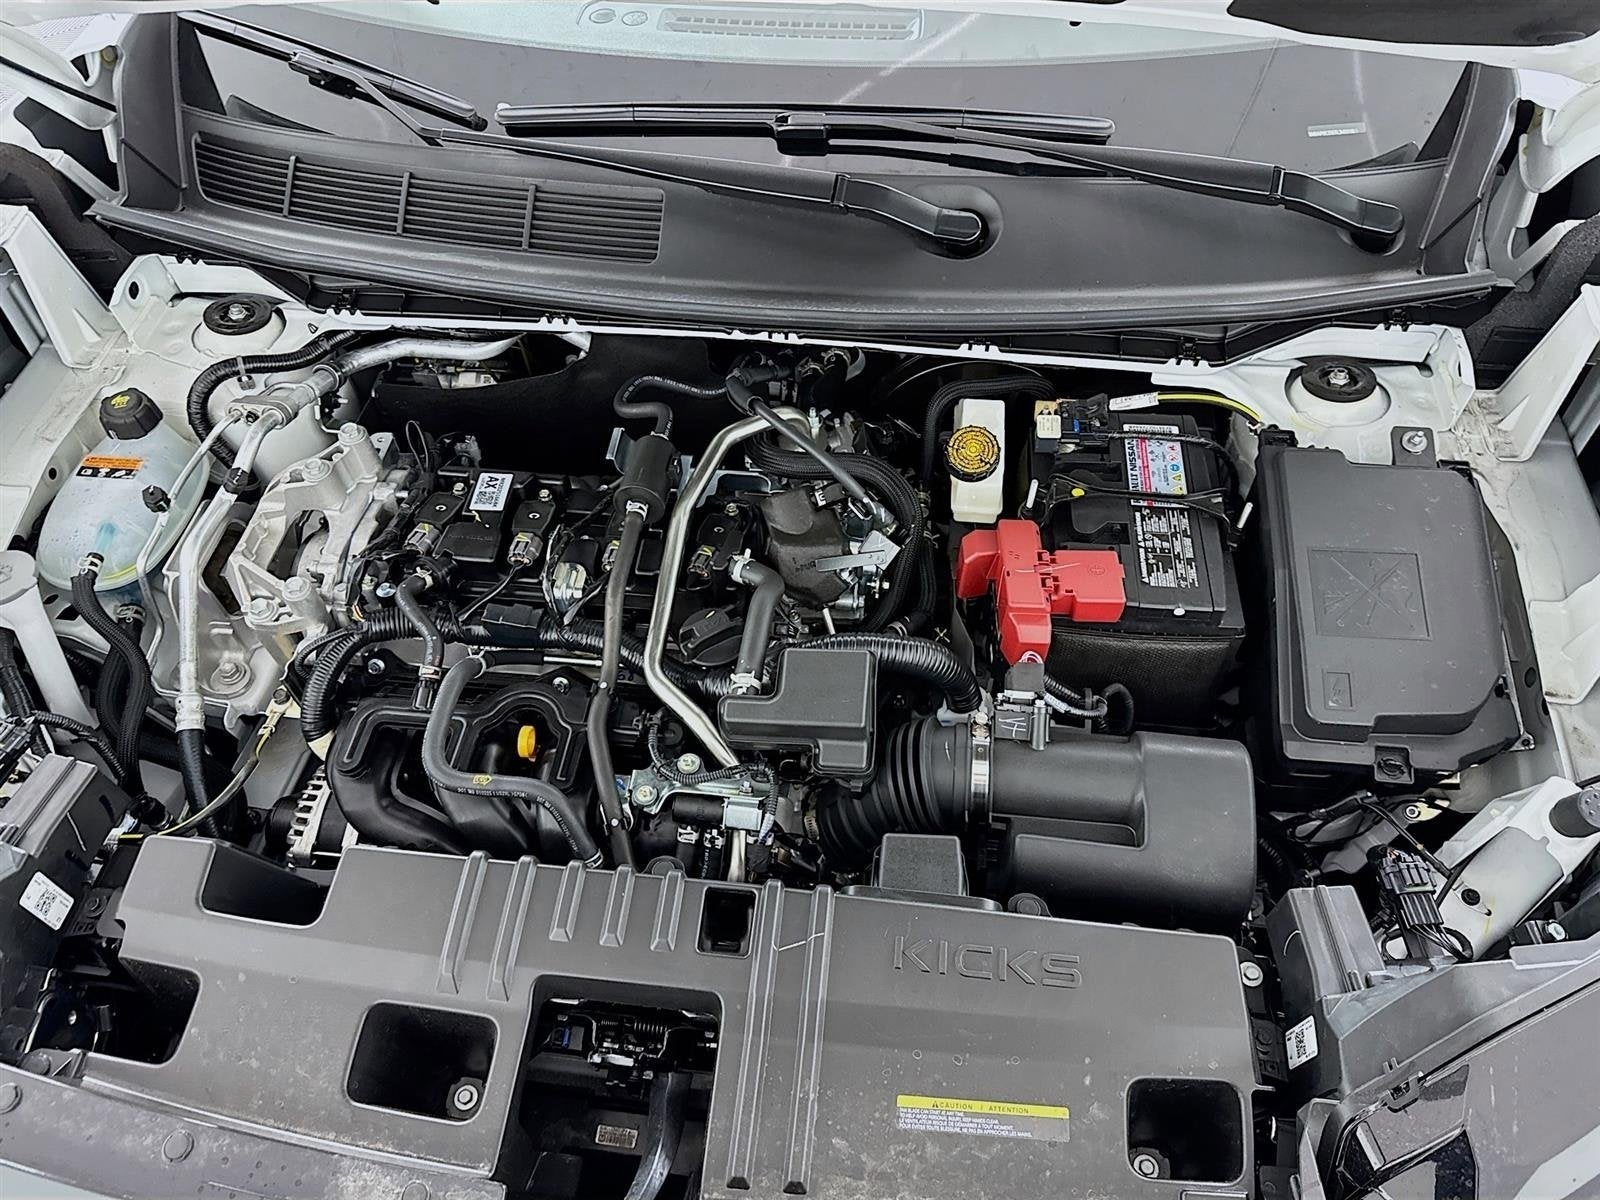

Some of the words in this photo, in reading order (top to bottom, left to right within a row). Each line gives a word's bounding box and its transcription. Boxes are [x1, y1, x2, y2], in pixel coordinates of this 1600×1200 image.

[484, 476, 500, 489] AX
[894, 936, 1082, 989] KICKS
[940, 1102, 973, 1110] CAUTION
[988, 1105, 1029, 1114] ATTENTION
